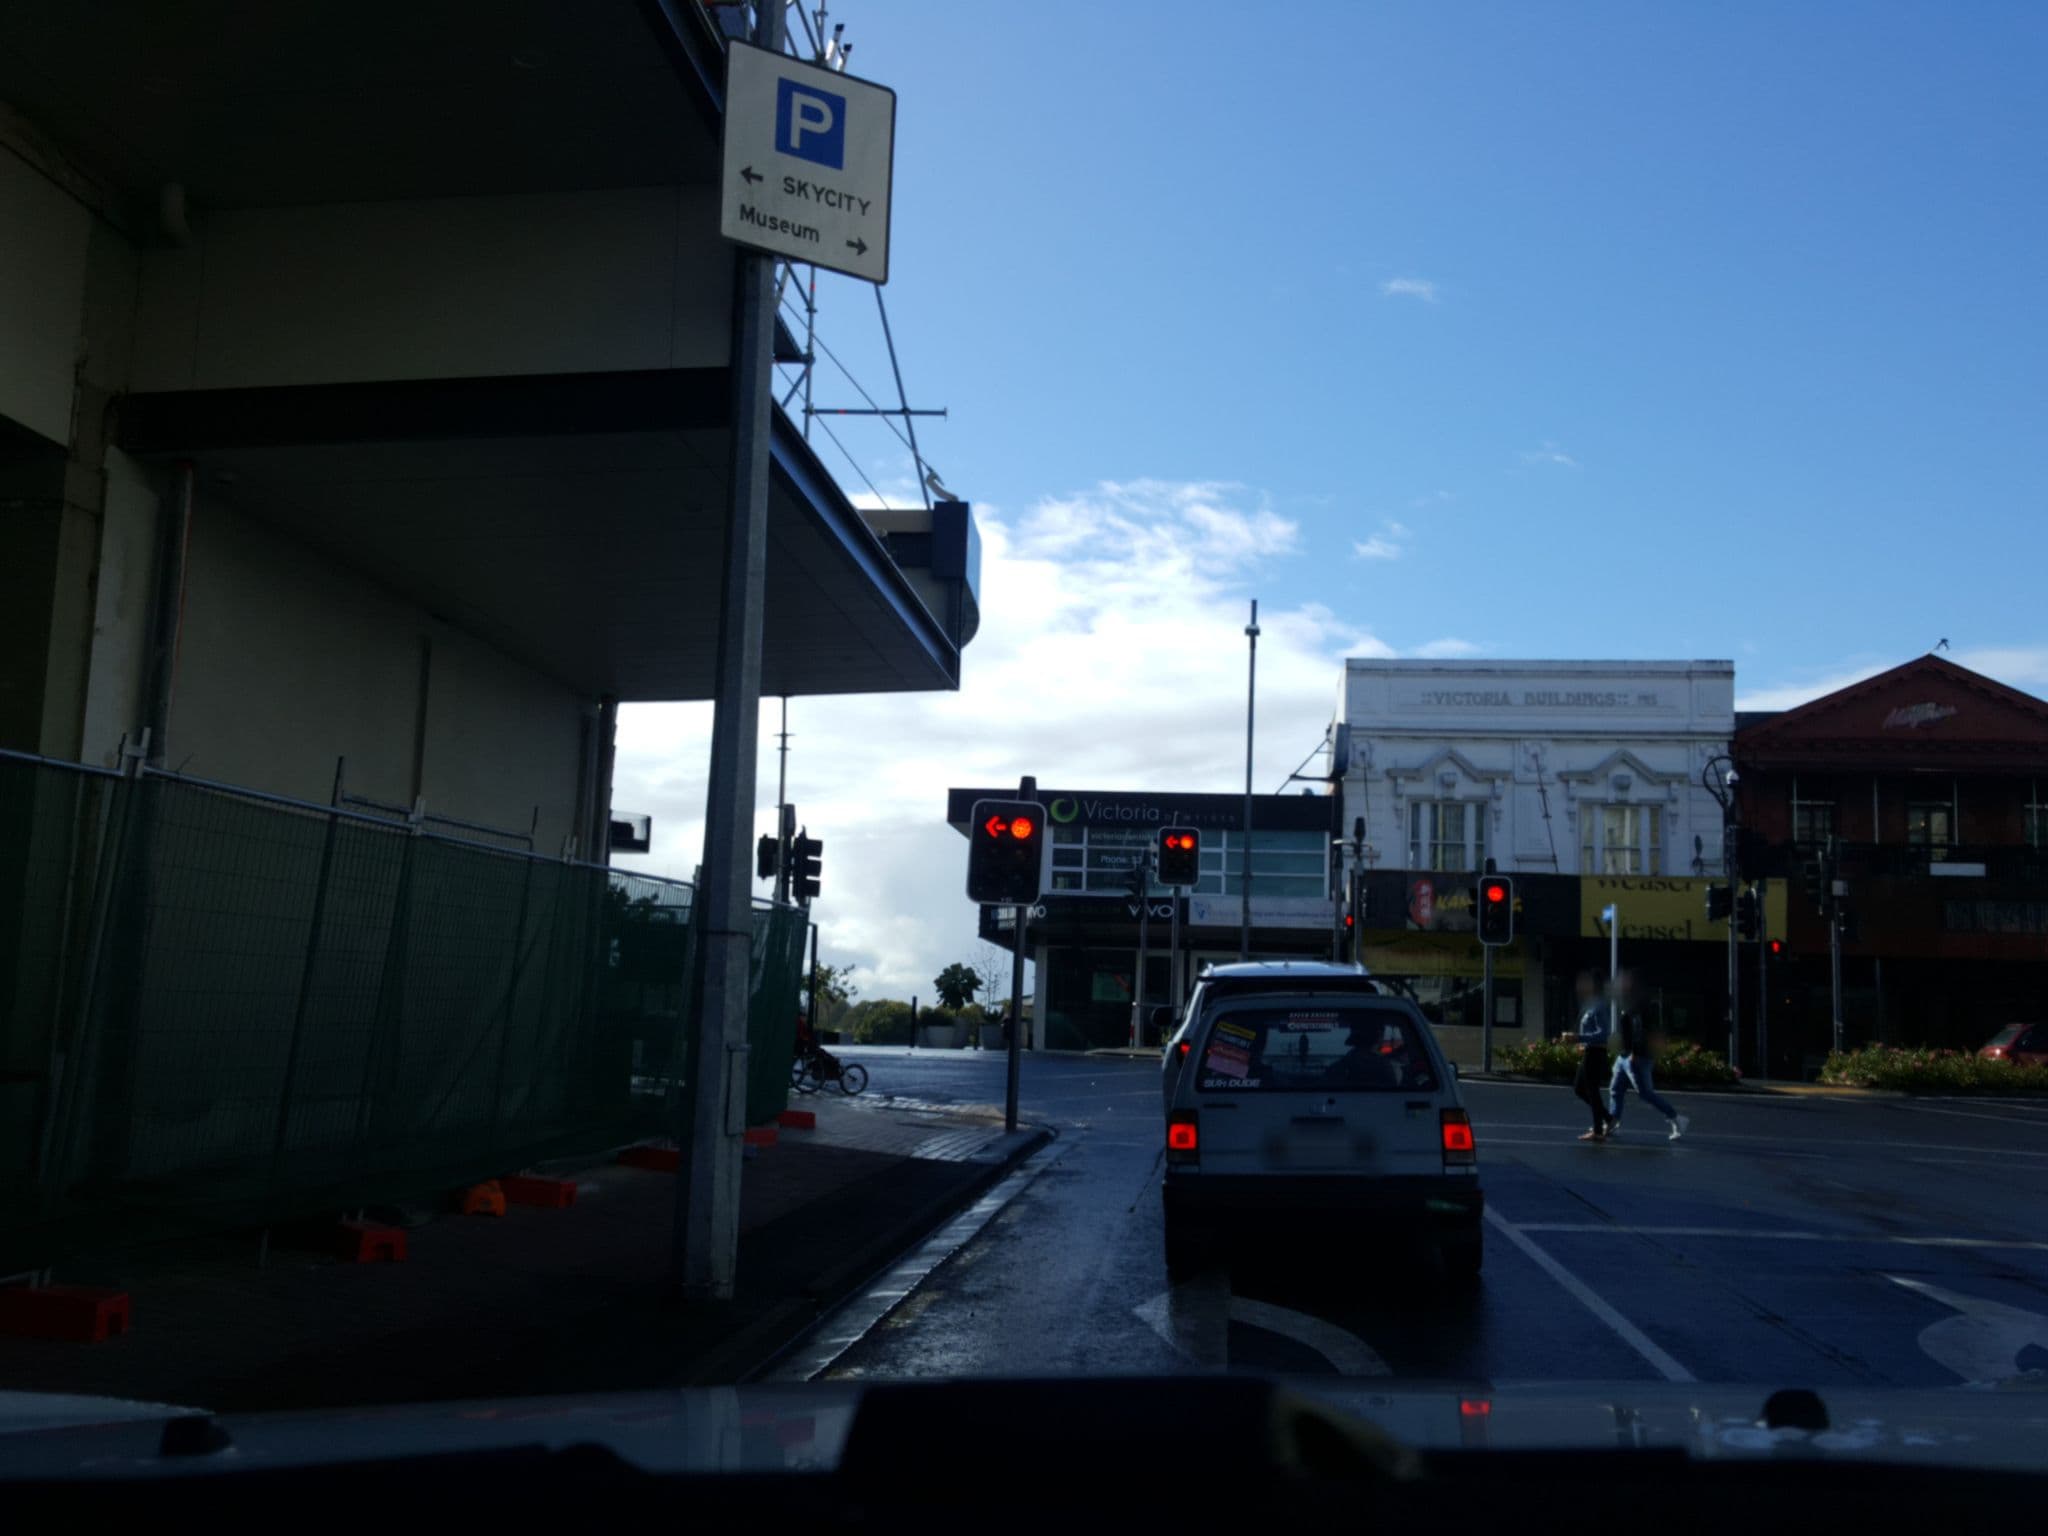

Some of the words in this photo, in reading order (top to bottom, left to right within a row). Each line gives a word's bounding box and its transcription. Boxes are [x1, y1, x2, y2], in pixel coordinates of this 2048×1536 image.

[790, 92, 834, 149] P
[783, 176, 871, 217] SKYCITY
[739, 203, 820, 244] Museum
[1432, 691, 1513, 706] VICTORIA
[1083, 799, 1160, 821] Victoria
